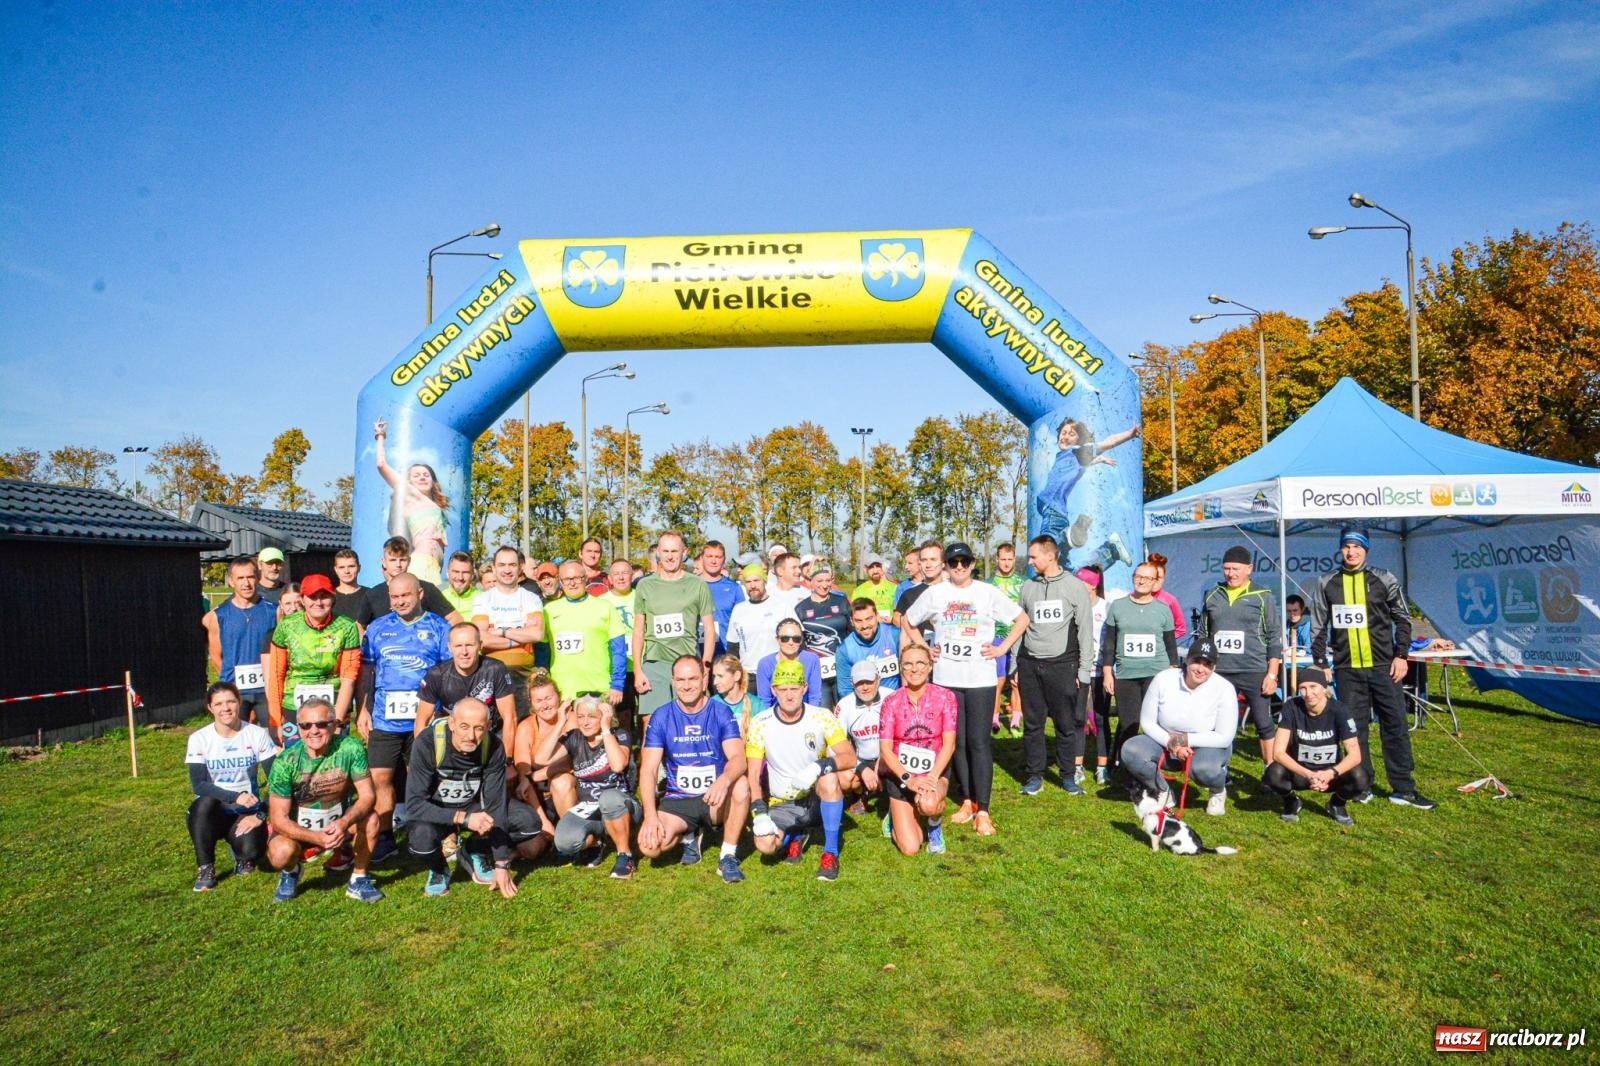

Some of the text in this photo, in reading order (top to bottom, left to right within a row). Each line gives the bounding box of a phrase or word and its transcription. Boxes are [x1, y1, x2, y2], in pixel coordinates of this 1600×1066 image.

[683, 241, 802, 256] Gmina
[674, 286, 812, 310] Wielkie
[975, 260, 1103, 375] Gmina ludzi
[391, 269, 517, 386] Gmina ludzi
[954, 286, 1075, 396] aktywnych
[416, 294, 536, 407] aktywnych
[1303, 486, 1424, 507] PersonalBest
[1561, 493, 1592, 502] MITKO
[1036, 608, 1061, 619] 166
[1335, 613, 1364, 624] 159
[656, 622, 682, 634] 303
[556, 640, 581, 650] 337
[944, 643, 972, 656] 192
[1126, 642, 1154, 652] 318
[1216, 639, 1242, 649] 149
[876, 662, 897, 674] 49
[389, 702, 418, 713] 151
[205, 754, 256, 769] UNNERS
[900, 754, 931, 770] 309
[1302, 752, 1334, 760] 157
[680, 776, 713, 788] 305
[438, 788, 474, 798] 332
